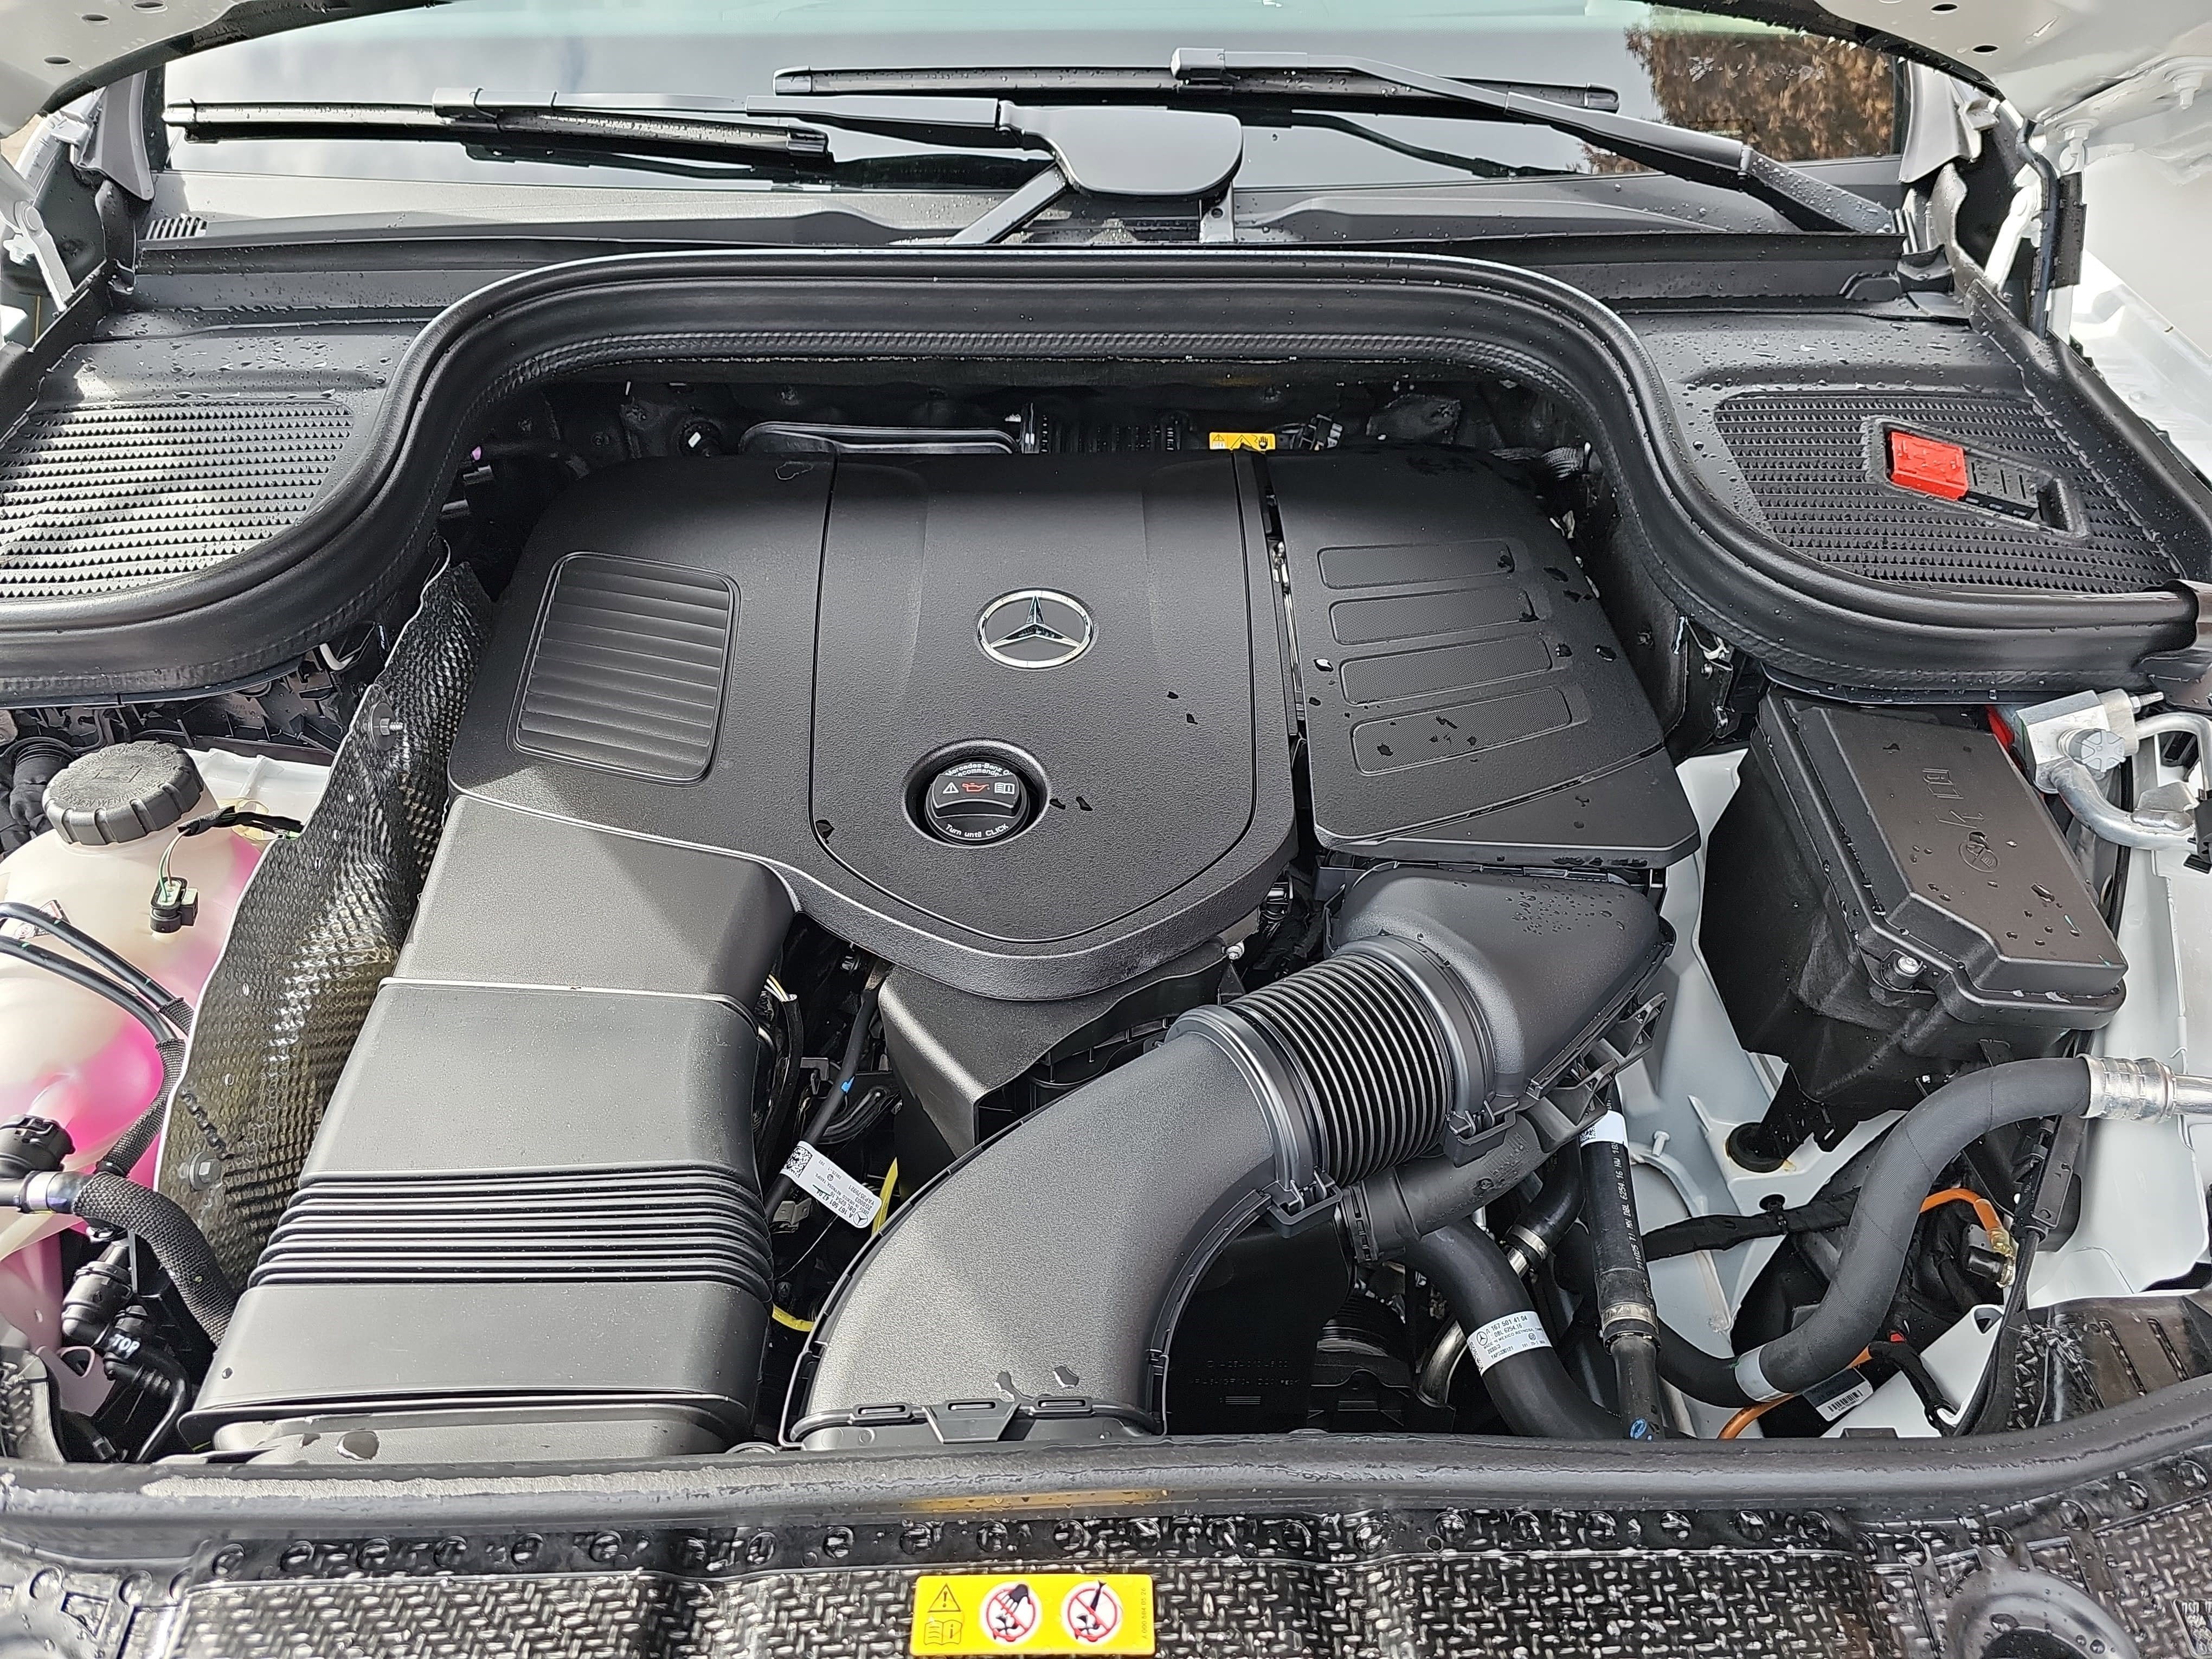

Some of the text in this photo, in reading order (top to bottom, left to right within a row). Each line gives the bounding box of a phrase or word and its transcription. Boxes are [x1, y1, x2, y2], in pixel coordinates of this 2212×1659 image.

[945, 763, 1002, 776] Mercedes-Benz
[946, 824, 962, 835] Turn
[985, 824, 1008, 836] CLICK
[848, 1185, 875, 1206] YAP3579921
[829, 1199, 839, 1208] 501
[830, 1192, 857, 1212] DBL 6254.16
[1622, 1204, 1631, 1217] DBL
[1491, 1323, 1500, 1331] 167
[1504, 1323, 1522, 1333] 6254.16
[1499, 1332, 1514, 1341] MEXICO
[112, 1334, 140, 1359] TOP
